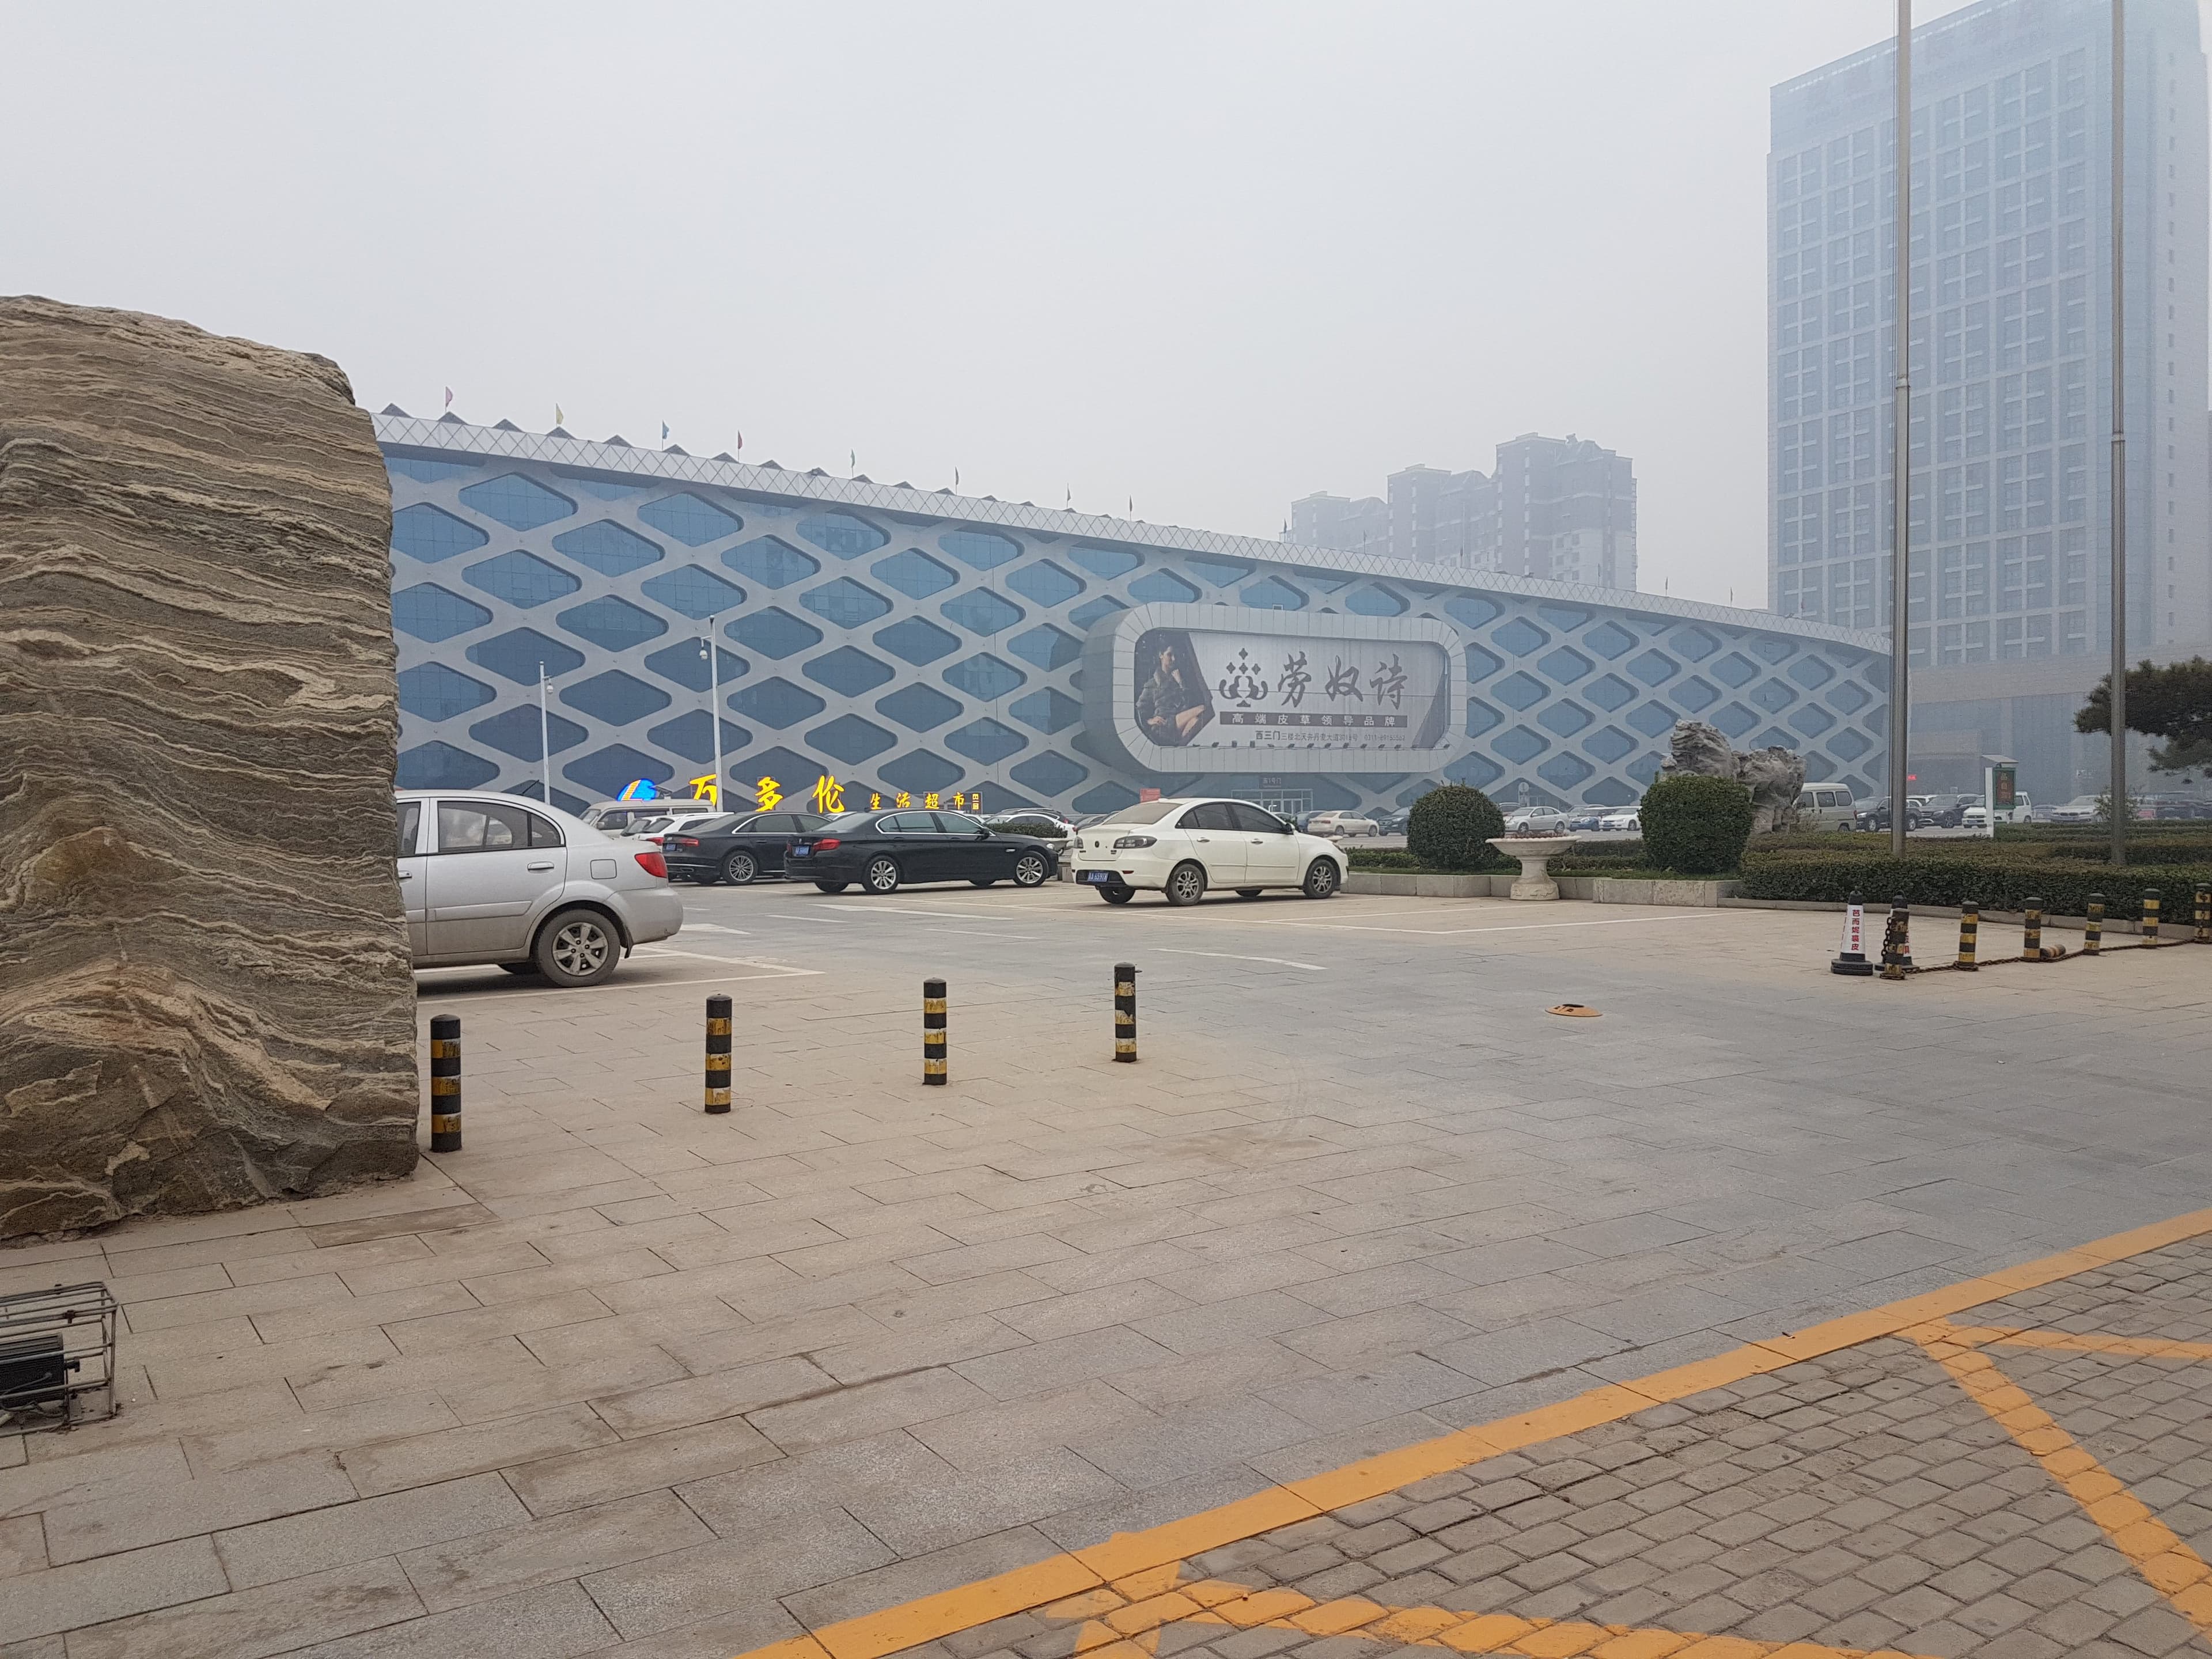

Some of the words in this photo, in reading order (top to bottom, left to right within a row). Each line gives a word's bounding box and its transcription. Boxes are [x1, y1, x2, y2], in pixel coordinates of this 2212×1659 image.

[1232, 713, 1396, 726] 高端皮草领导品牌
[870, 791, 964, 810] 生活超市
